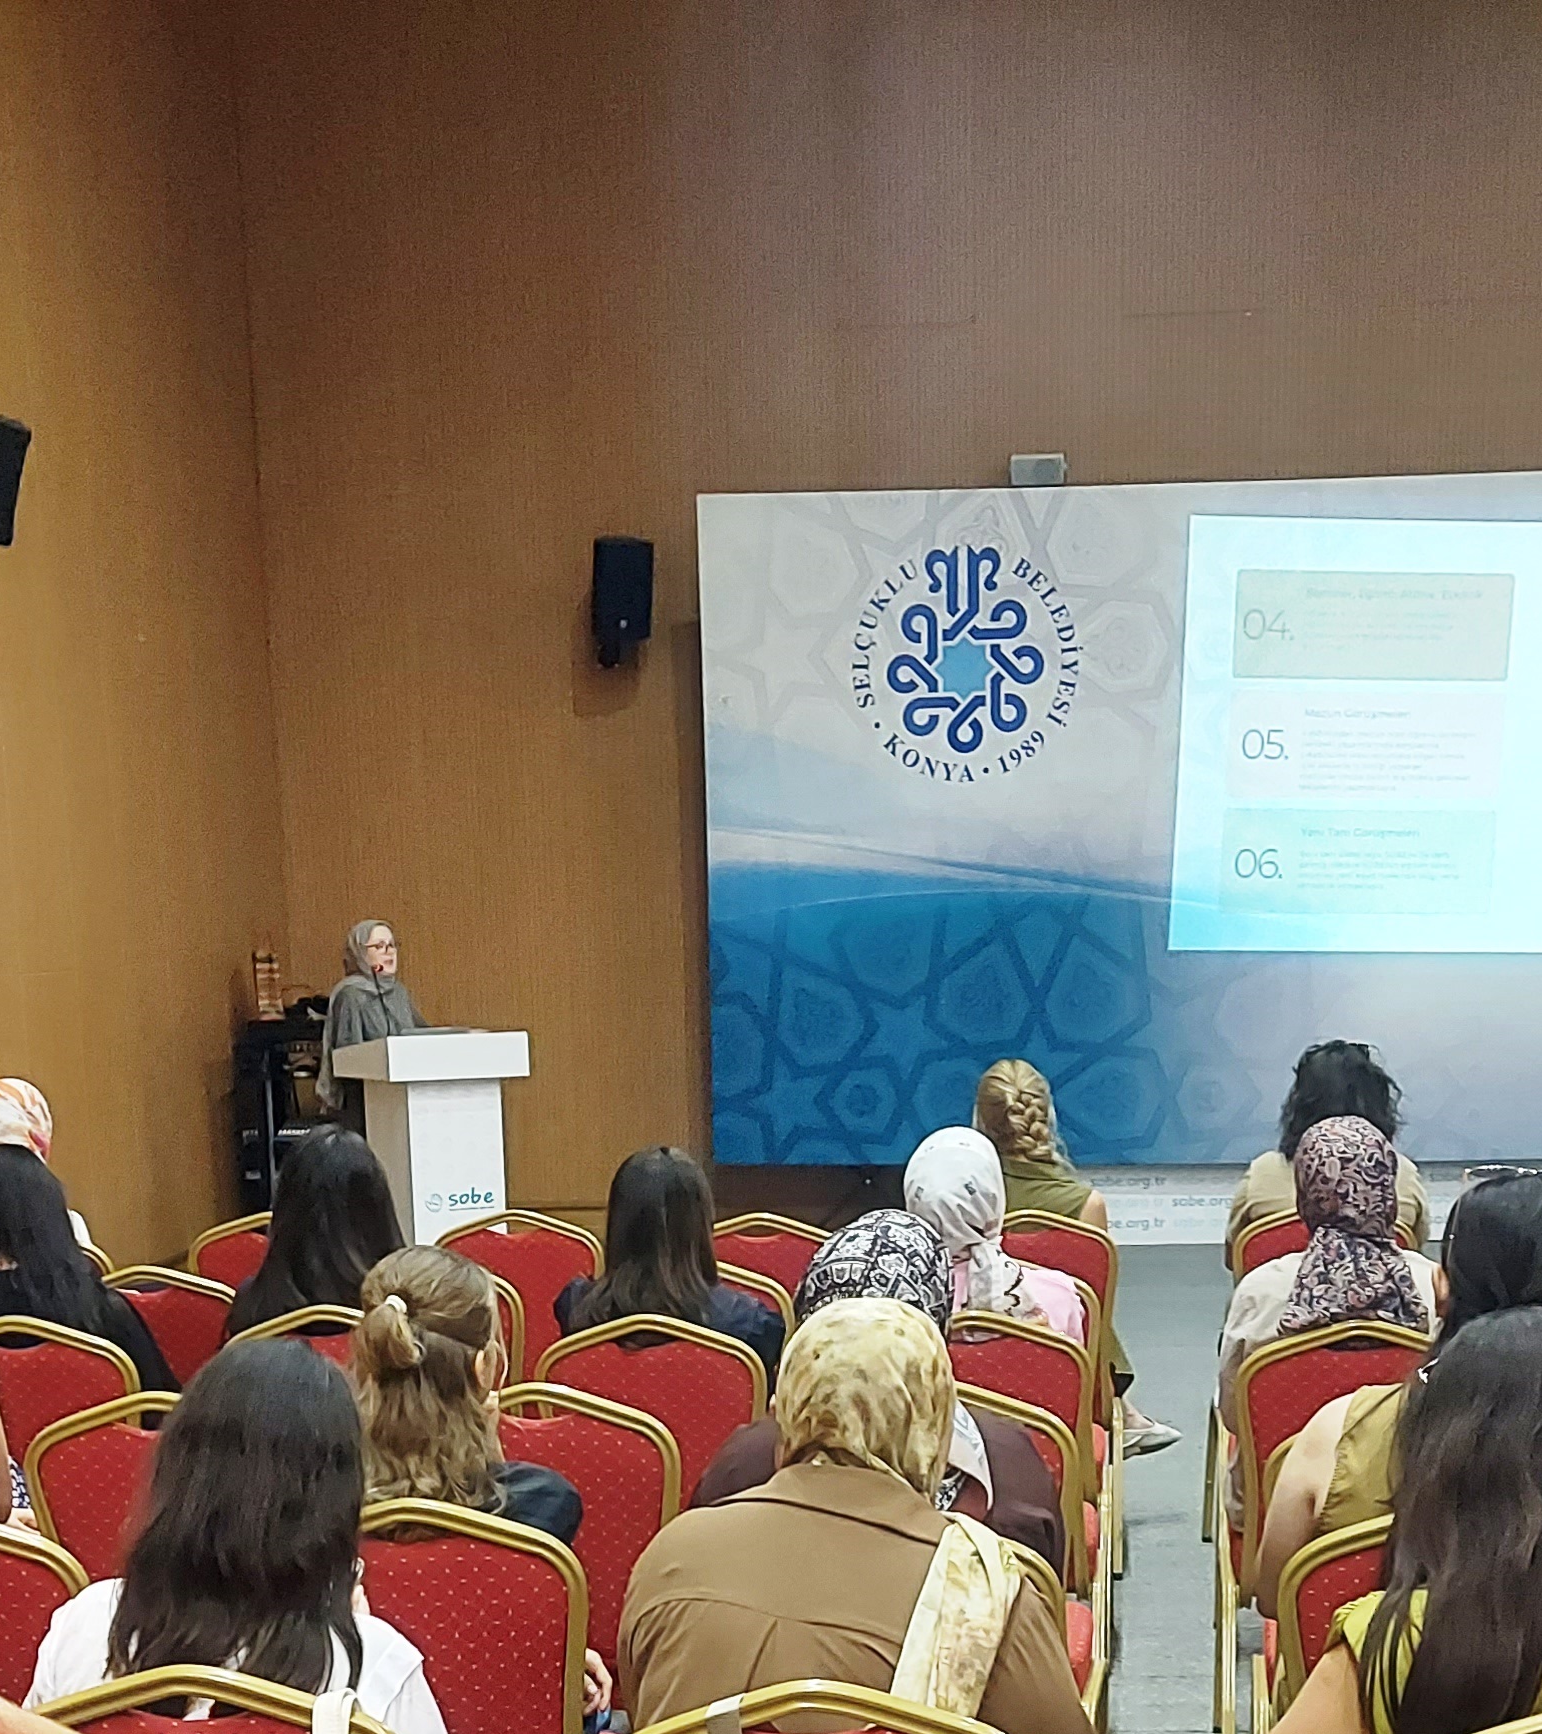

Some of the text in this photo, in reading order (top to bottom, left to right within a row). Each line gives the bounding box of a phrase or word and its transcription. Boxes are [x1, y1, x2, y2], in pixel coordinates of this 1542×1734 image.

[1242, 608, 1295, 641] 04.
[852, 557, 1084, 728] SELÇUKLU BELEDİYESİ
[883, 730, 1045, 782] KONYA 1989
[1242, 729, 1289, 760] 05.
[1234, 848, 1283, 879] 06.
[449, 1186, 494, 1207] sobe
[1172, 1195, 1233, 1209] sobe.org
